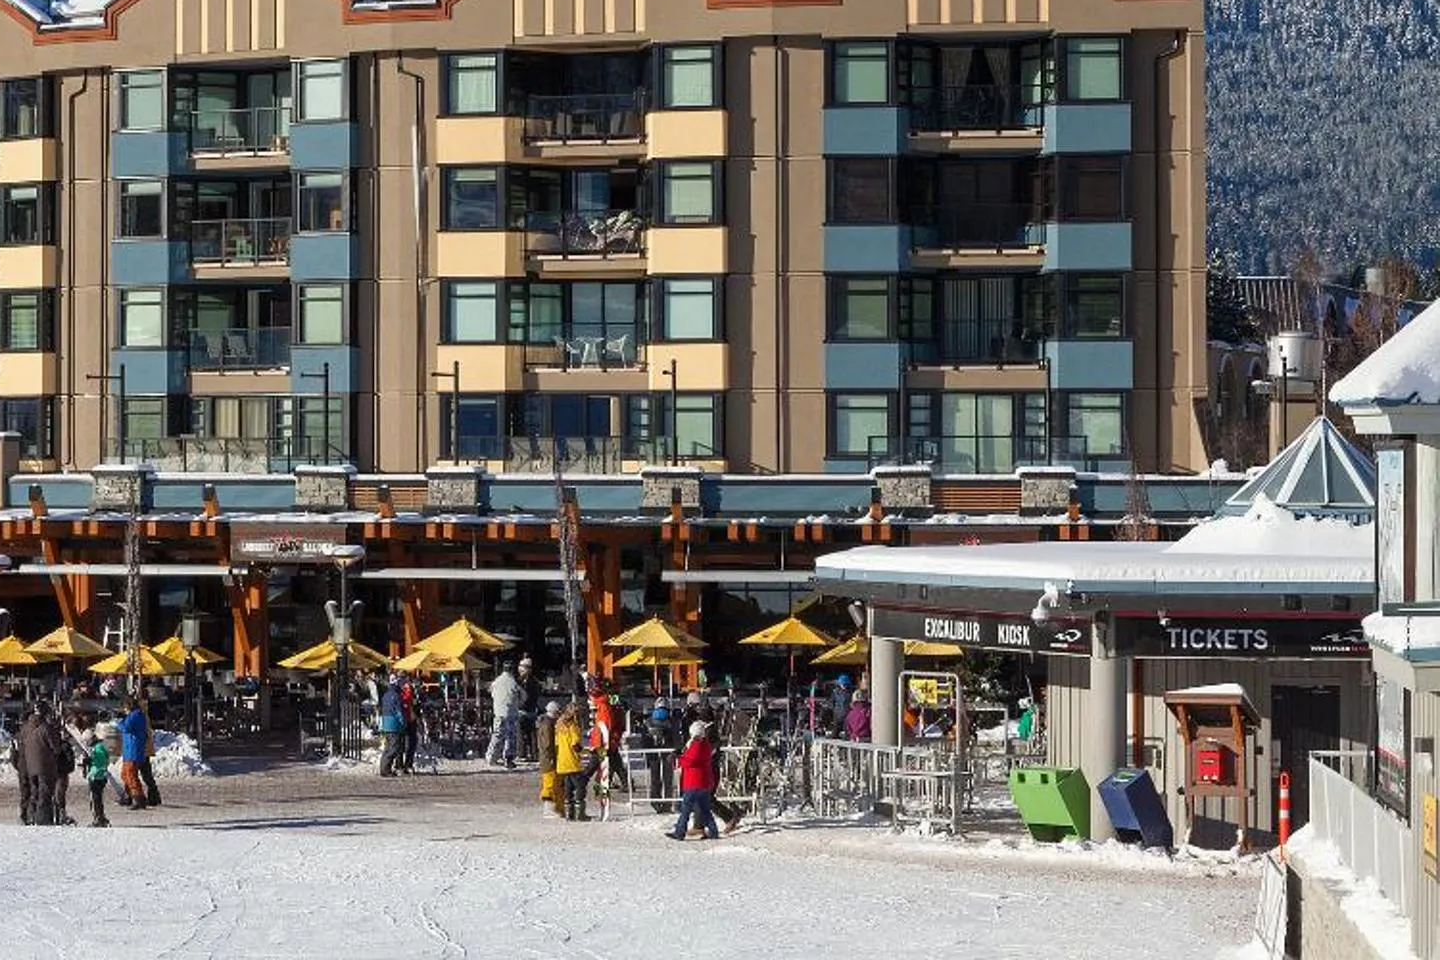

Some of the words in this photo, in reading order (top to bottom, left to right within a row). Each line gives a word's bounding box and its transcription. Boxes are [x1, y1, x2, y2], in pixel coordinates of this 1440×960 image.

[924, 618, 980, 642] EXCALIBUR
[997, 624, 1030, 646] KIOSK
[1165, 628, 1269, 650] TICKETS
